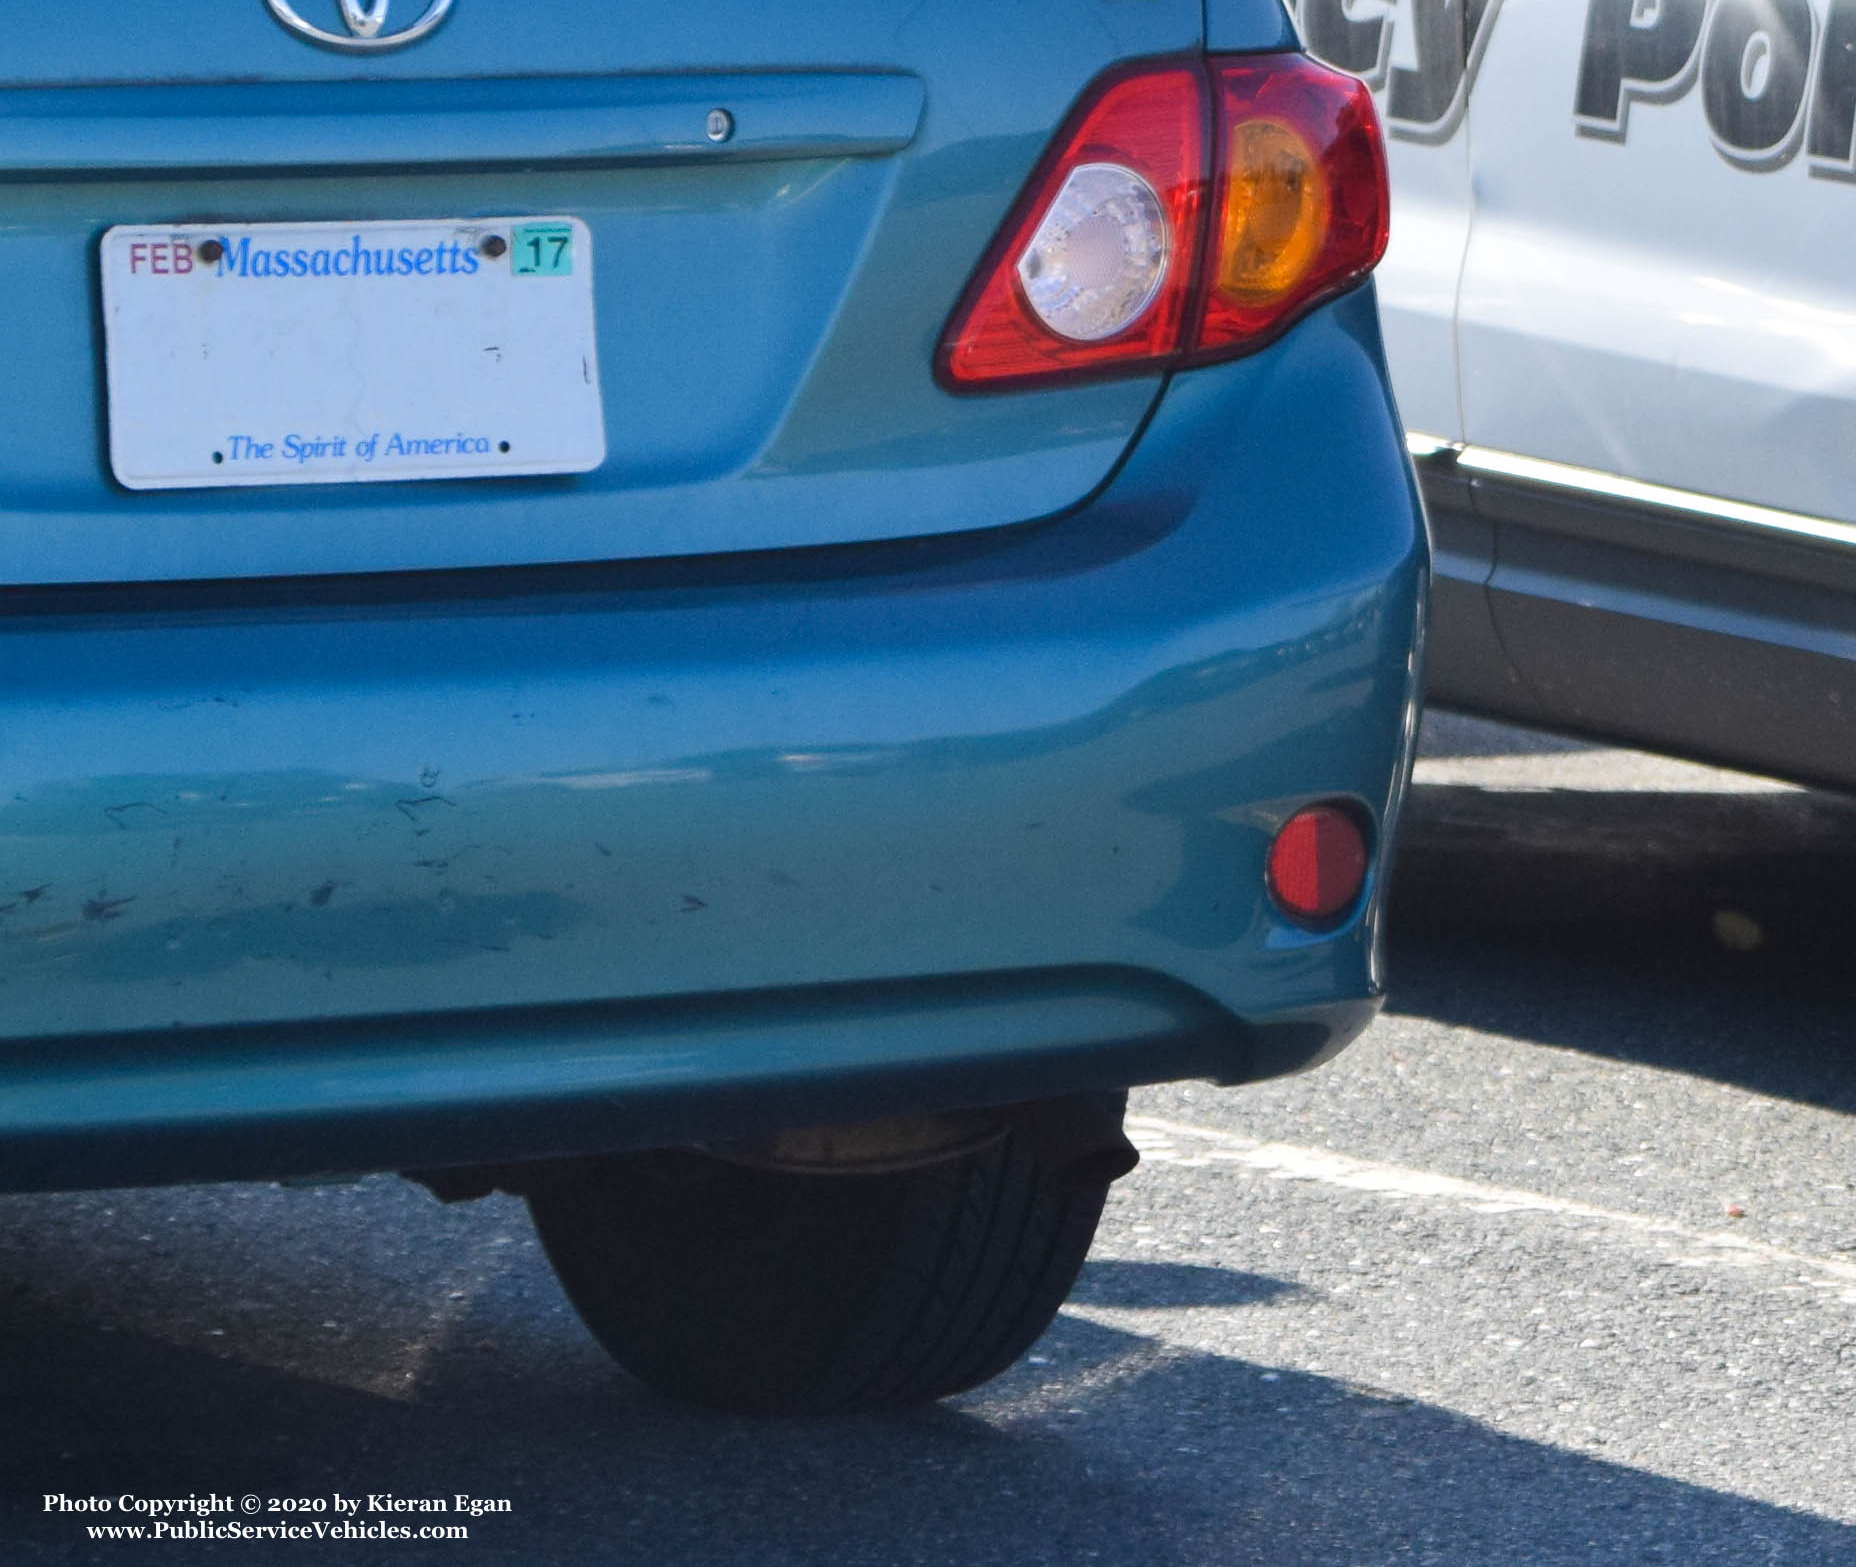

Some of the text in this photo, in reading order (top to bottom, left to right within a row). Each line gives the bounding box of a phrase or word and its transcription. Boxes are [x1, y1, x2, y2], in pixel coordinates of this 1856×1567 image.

[130, 242, 194, 275] FEB
[215, 235, 480, 279] Massachusetts
[526, 236, 569, 269] 17
[227, 432, 491, 464] The Spirit of America
